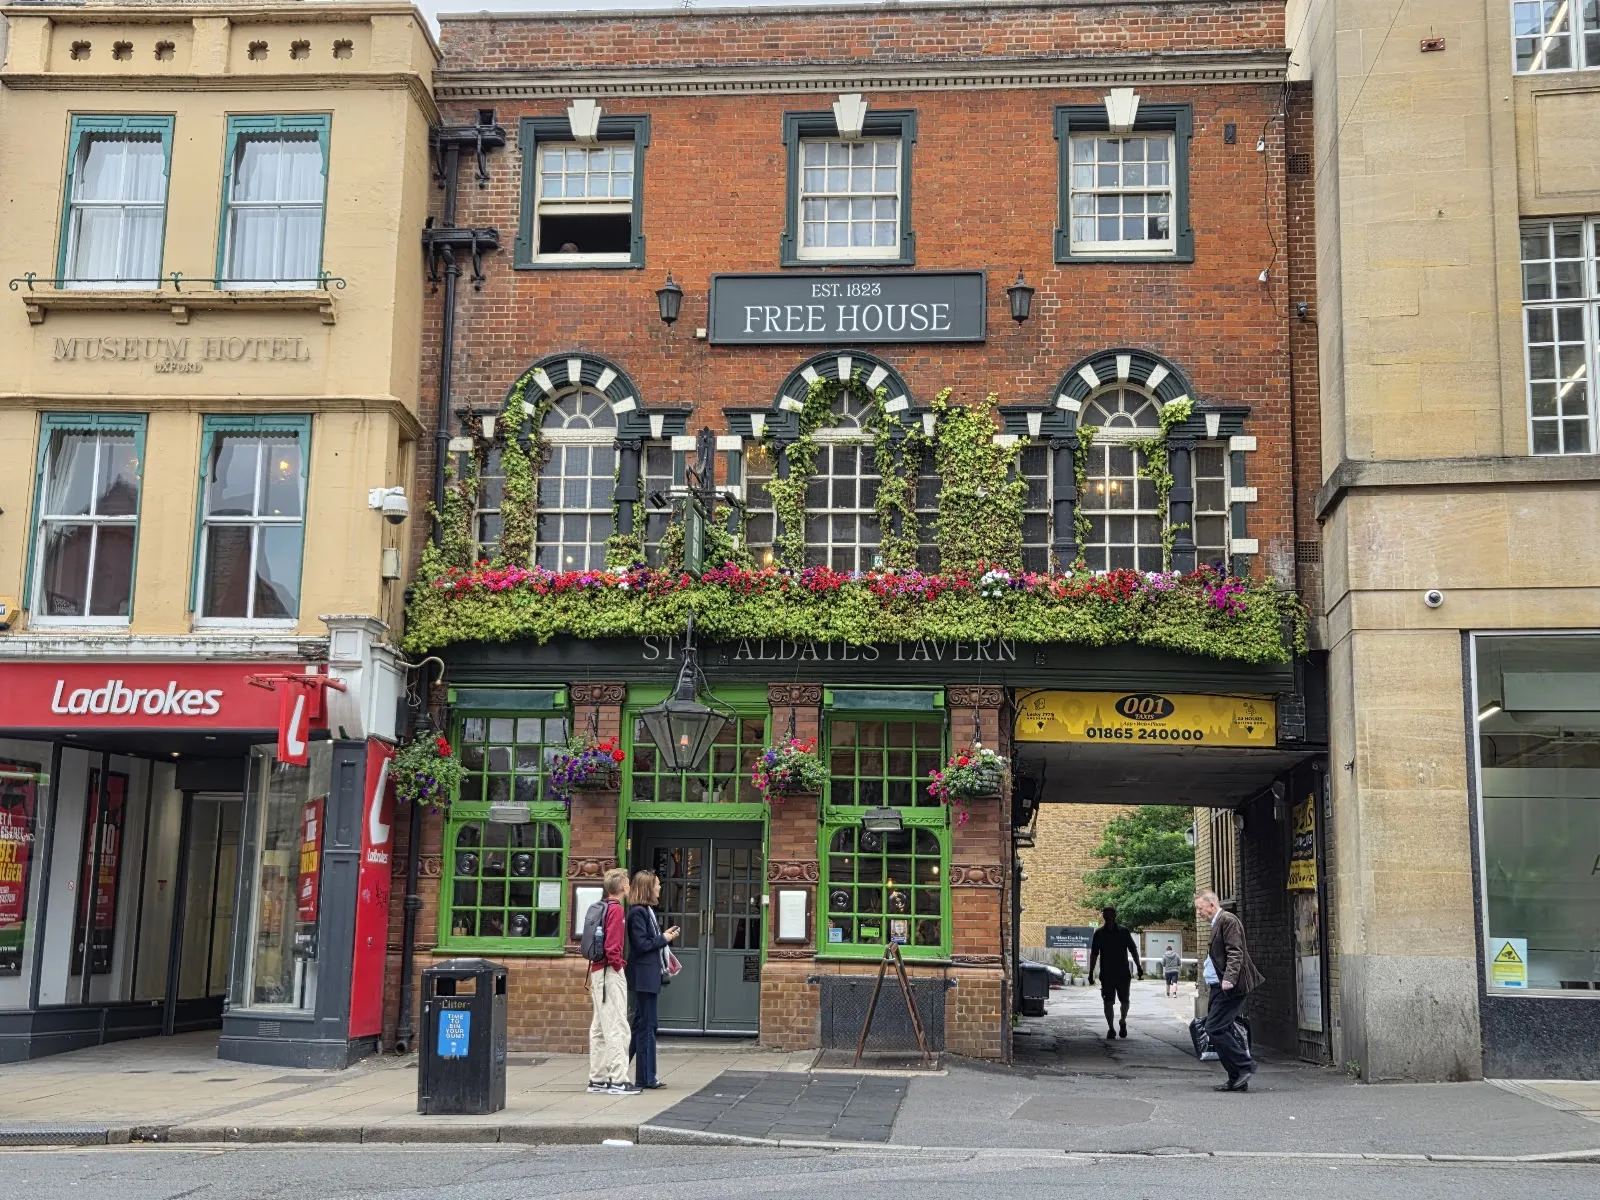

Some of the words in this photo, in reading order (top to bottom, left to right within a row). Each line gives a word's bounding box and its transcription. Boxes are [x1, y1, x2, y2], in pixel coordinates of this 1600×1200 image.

[811, 284, 842, 298] EST.
[846, 283, 882, 297] 1823
[743, 304, 826, 333] FREE
[836, 303, 951, 332] HOUSE
[52, 337, 191, 361] MUSEUM
[199, 337, 311, 361] HOTEL
[154, 362, 203, 374] OXFORD
[51, 679, 223, 715] Ladbrokes
[1123, 697, 1164, 715] 001
[1086, 727, 1134, 739] 01865
[1138, 728, 1204, 741] 240000
[441, 1000, 467, 1009] Litter
